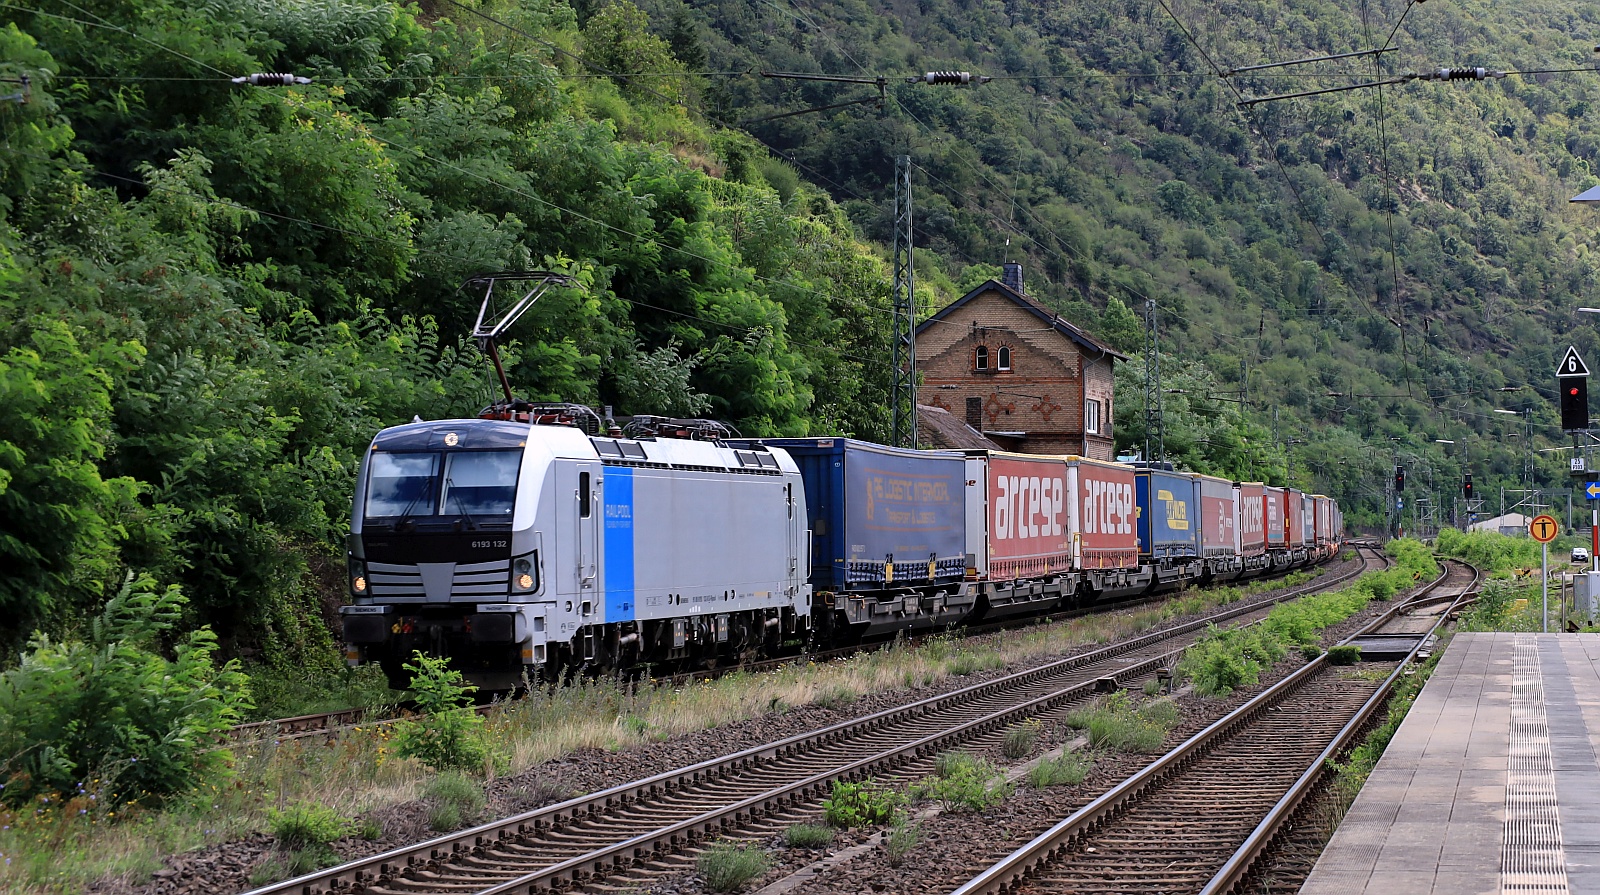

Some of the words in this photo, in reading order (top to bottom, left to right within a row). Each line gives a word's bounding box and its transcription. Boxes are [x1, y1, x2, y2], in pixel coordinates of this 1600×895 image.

[1568, 356, 1577, 373] 6
[605, 504, 631, 518] RAILPOOL
[995, 475, 1063, 540] arcese
[1084, 478, 1132, 535] arcese
[1243, 496, 1263, 534] arcese
[471, 540, 491, 548] 6193
[492, 540, 507, 548] 132
